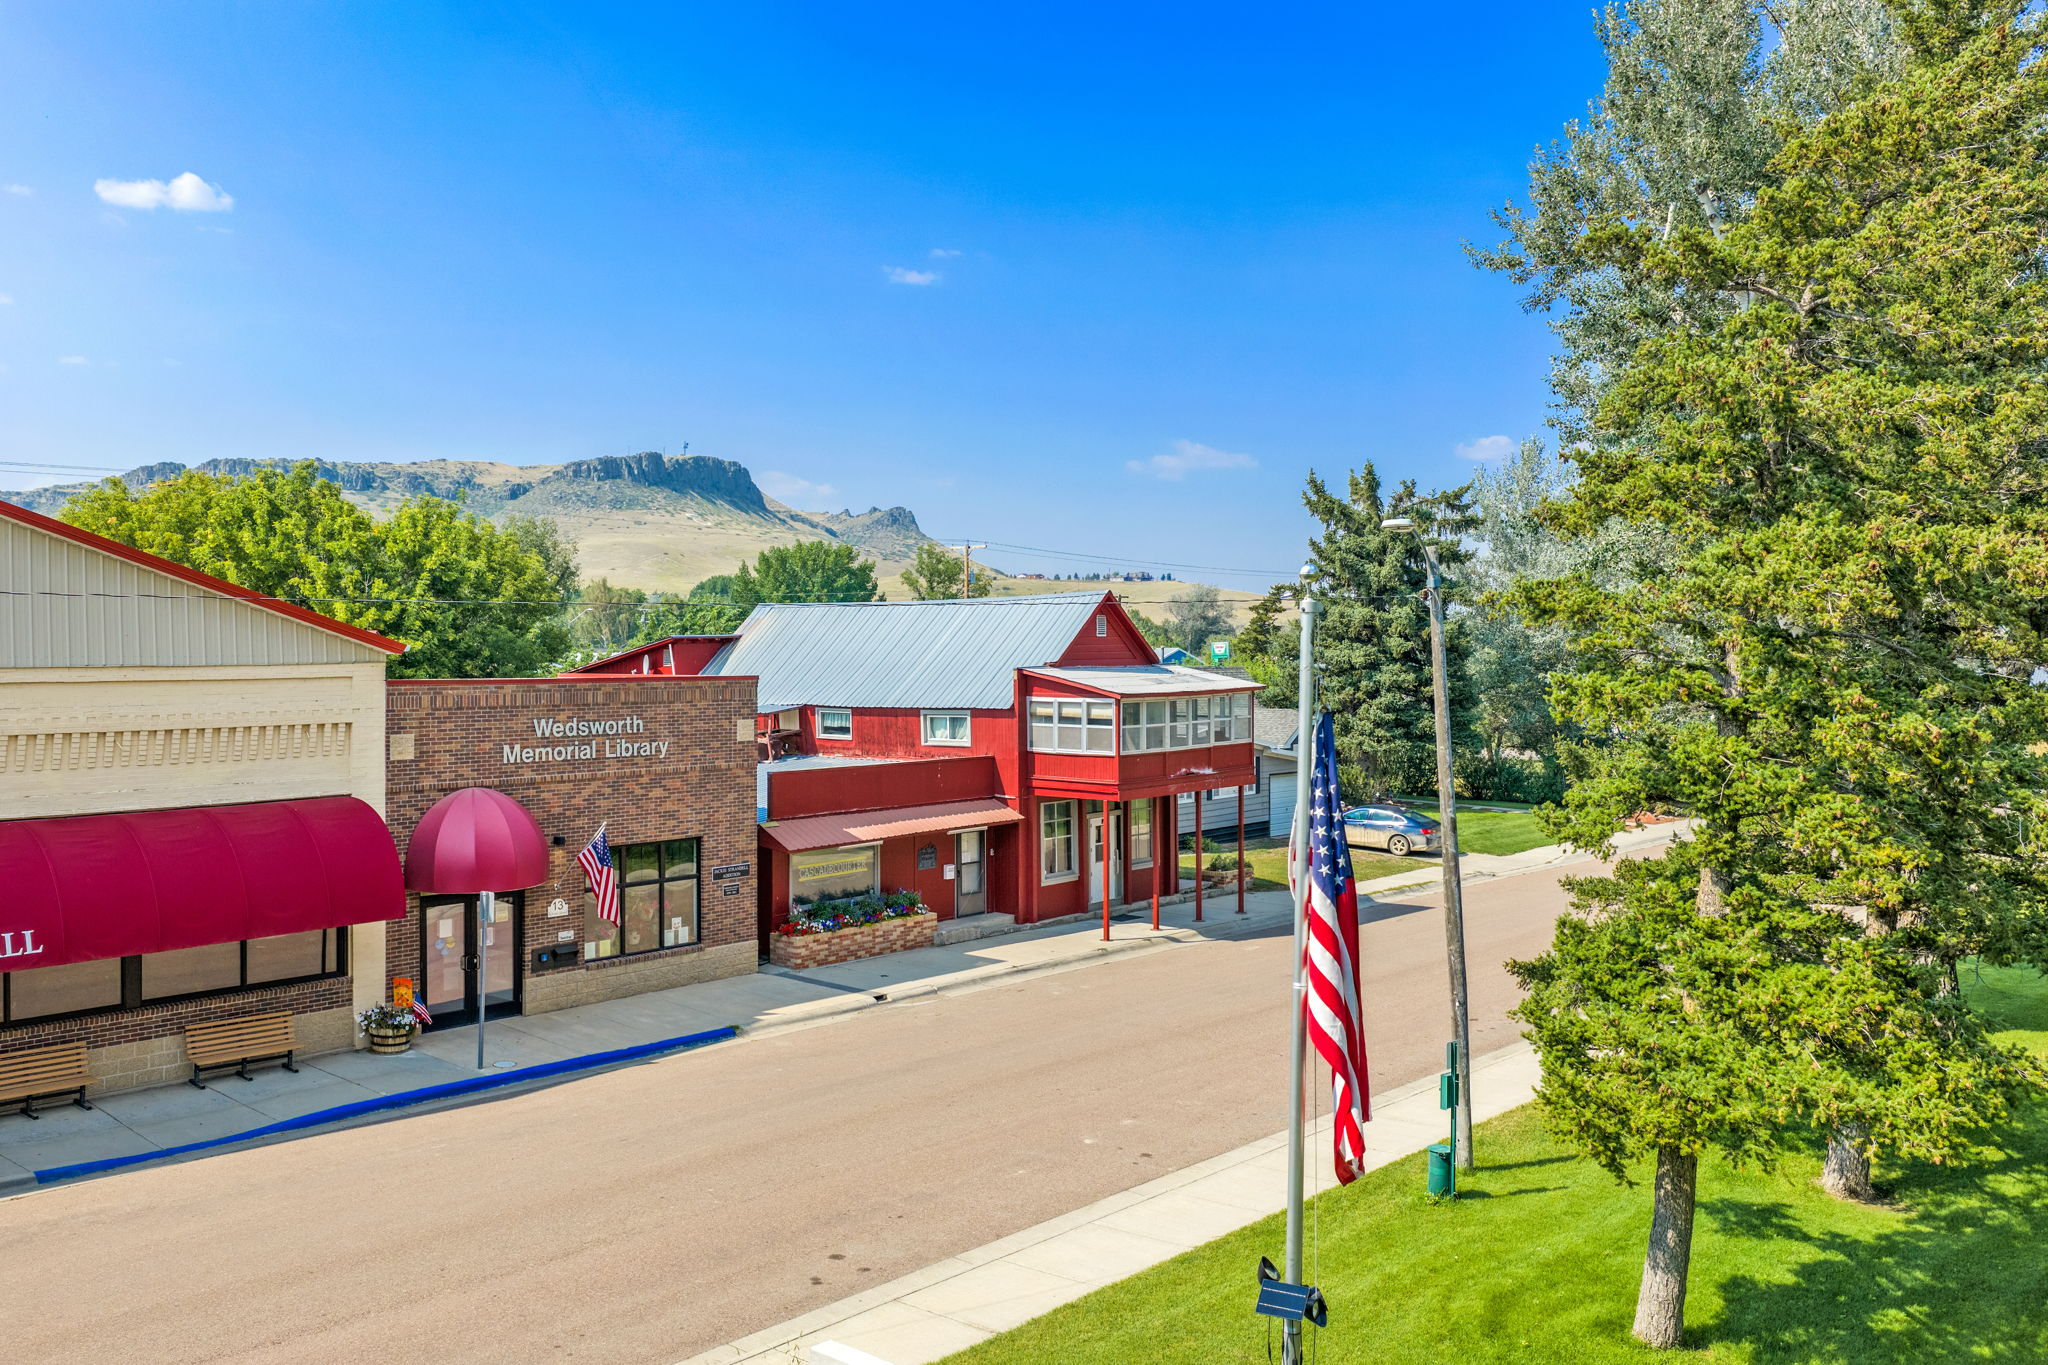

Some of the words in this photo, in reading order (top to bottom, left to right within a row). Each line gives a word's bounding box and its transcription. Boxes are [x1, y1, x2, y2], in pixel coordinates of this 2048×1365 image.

[533, 715, 644, 738] Wedsworth
[502, 740, 597, 764] Memorial
[605, 739, 669, 759] Library
[553, 901, 563, 910] 13
[0, 930, 44, 958] LL
